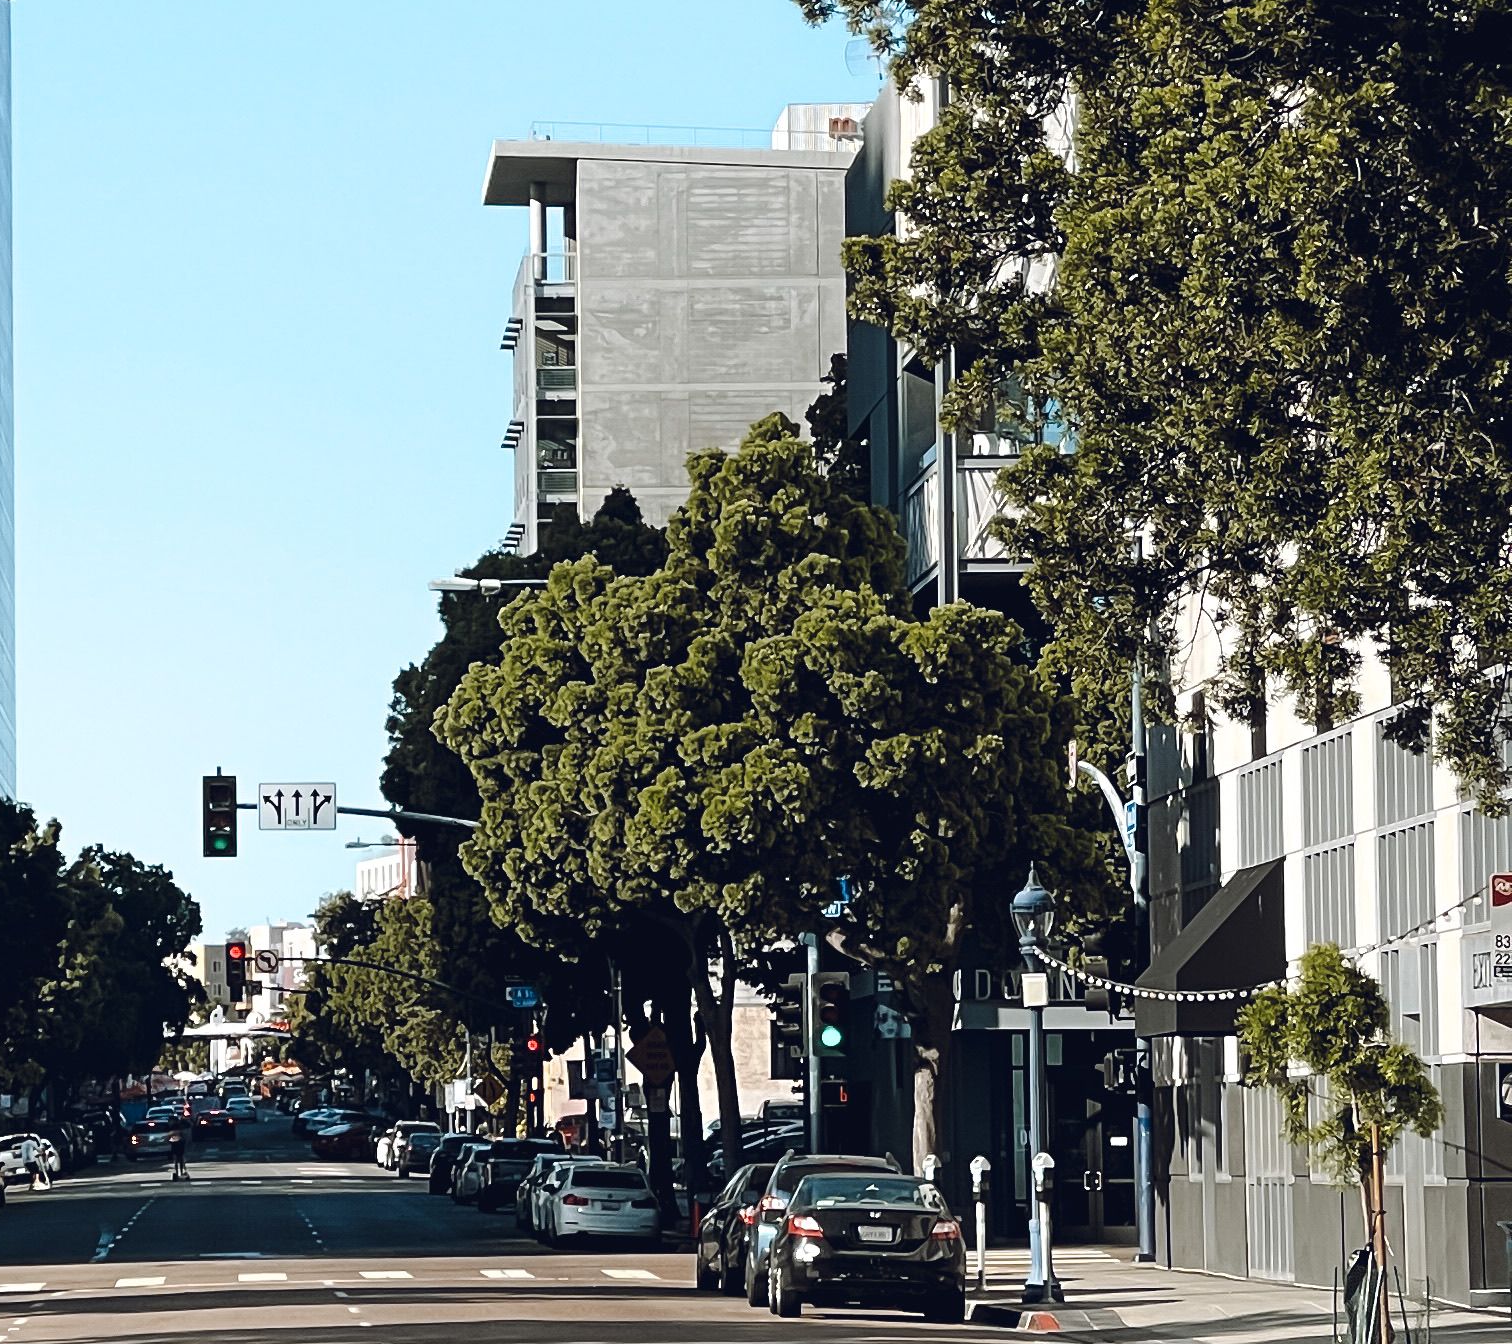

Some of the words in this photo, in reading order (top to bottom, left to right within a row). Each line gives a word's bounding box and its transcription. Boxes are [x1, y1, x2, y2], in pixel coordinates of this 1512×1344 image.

[288, 819, 307, 827] ONLY
[1495, 935, 1511, 948] 83
[1495, 954, 1512, 965] 22
